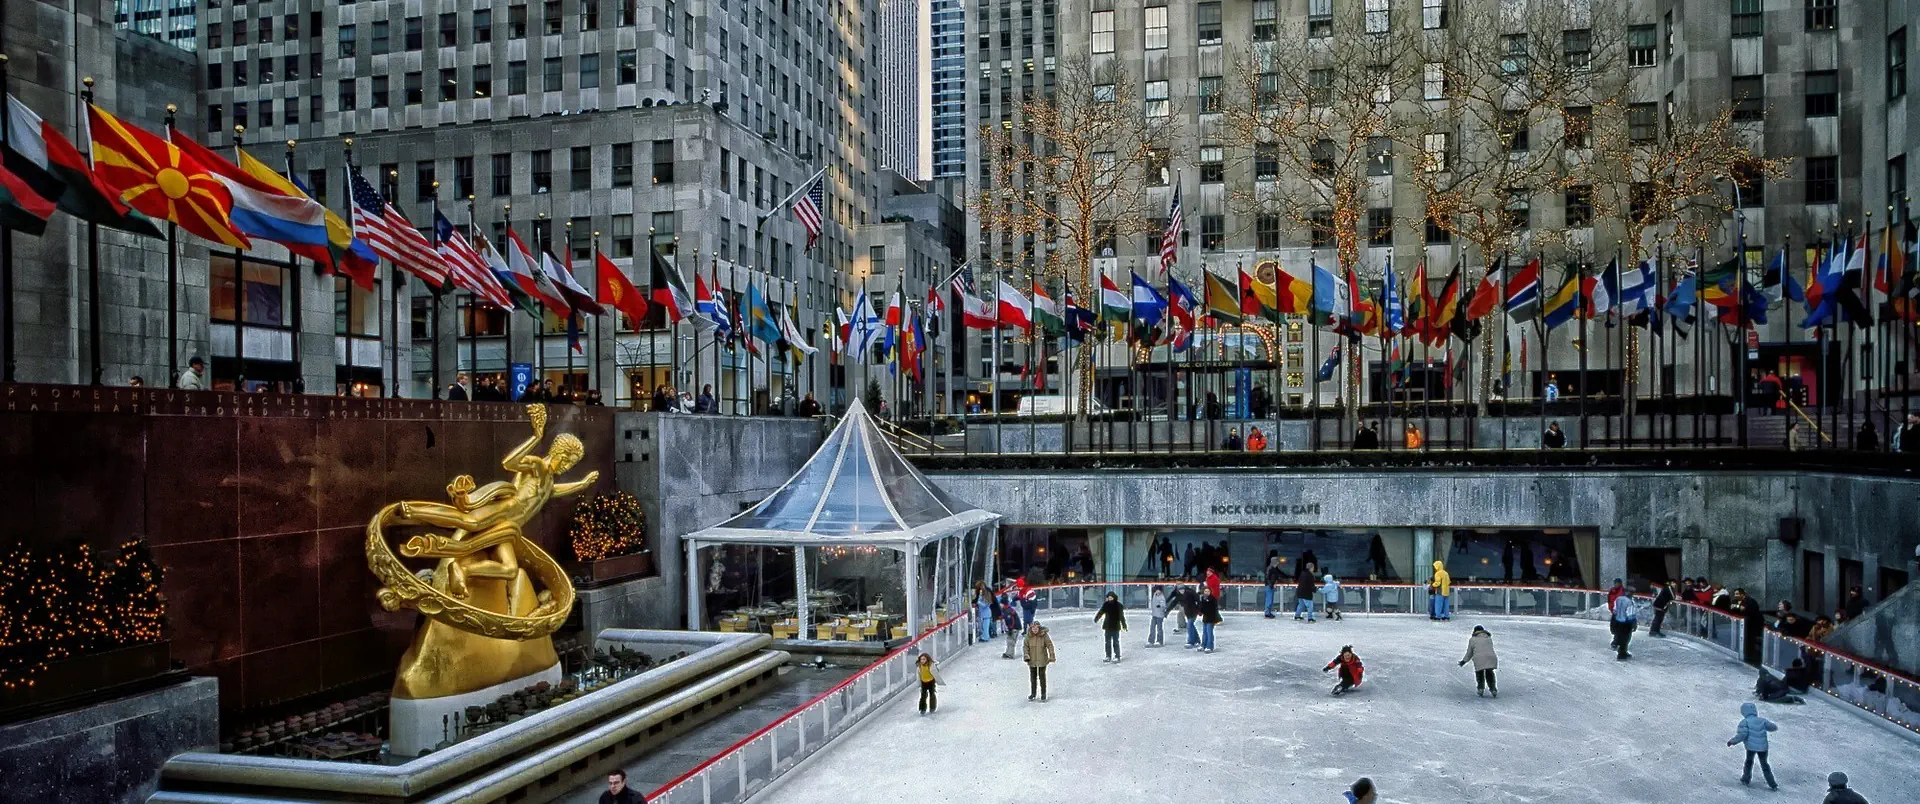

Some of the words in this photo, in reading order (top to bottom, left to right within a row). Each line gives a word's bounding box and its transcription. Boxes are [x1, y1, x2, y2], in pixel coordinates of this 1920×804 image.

[217, 394, 309, 406] TEACHER
[8, 402, 59, 412] HAT
[93, 404, 156, 415] HATH
[184, 406, 269, 417] PROVED
[290, 409, 311, 417] TO
[1211, 505, 1241, 515] ROCK
[1244, 505, 1288, 515] CENTER
